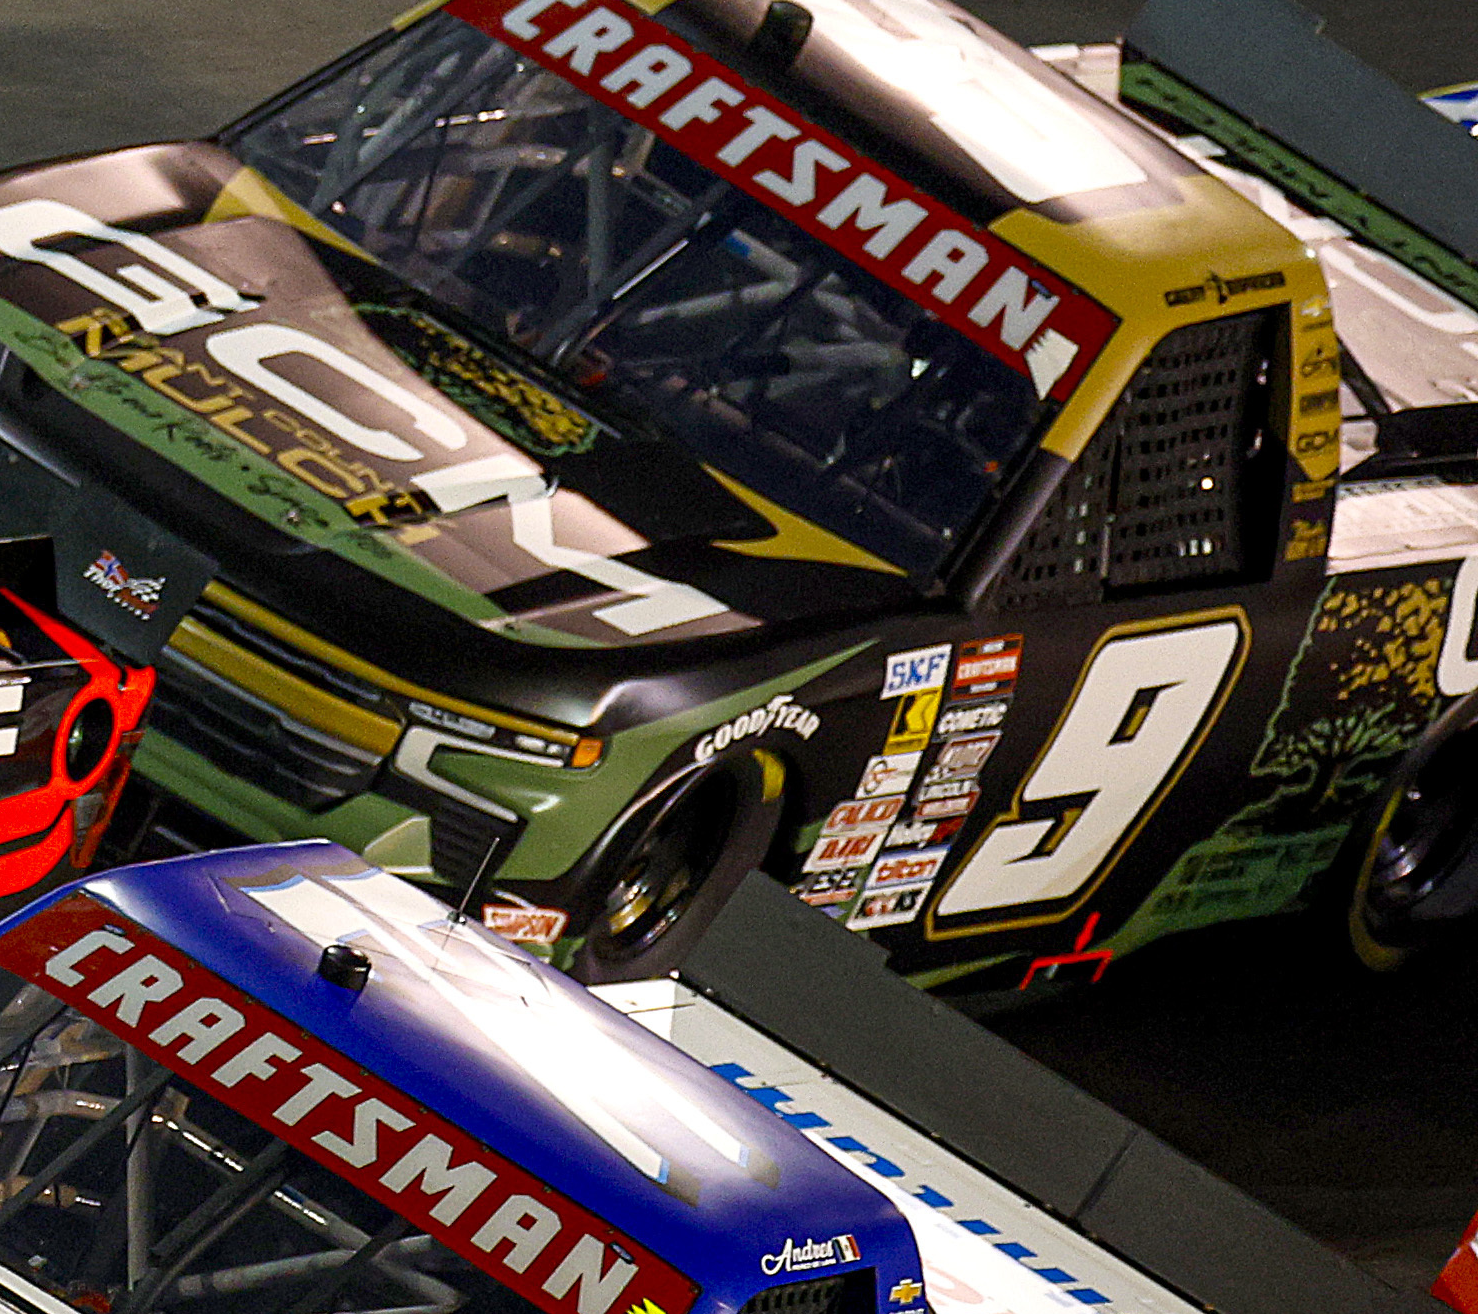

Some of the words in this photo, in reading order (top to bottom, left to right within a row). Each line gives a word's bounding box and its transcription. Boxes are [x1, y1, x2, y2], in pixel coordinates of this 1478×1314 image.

[889, 653, 946, 691] SKF
[694, 694, 820, 765] GOODYEAR
[931, 611, 1246, 929] 9
[761, 1237, 835, 1276] Andres
